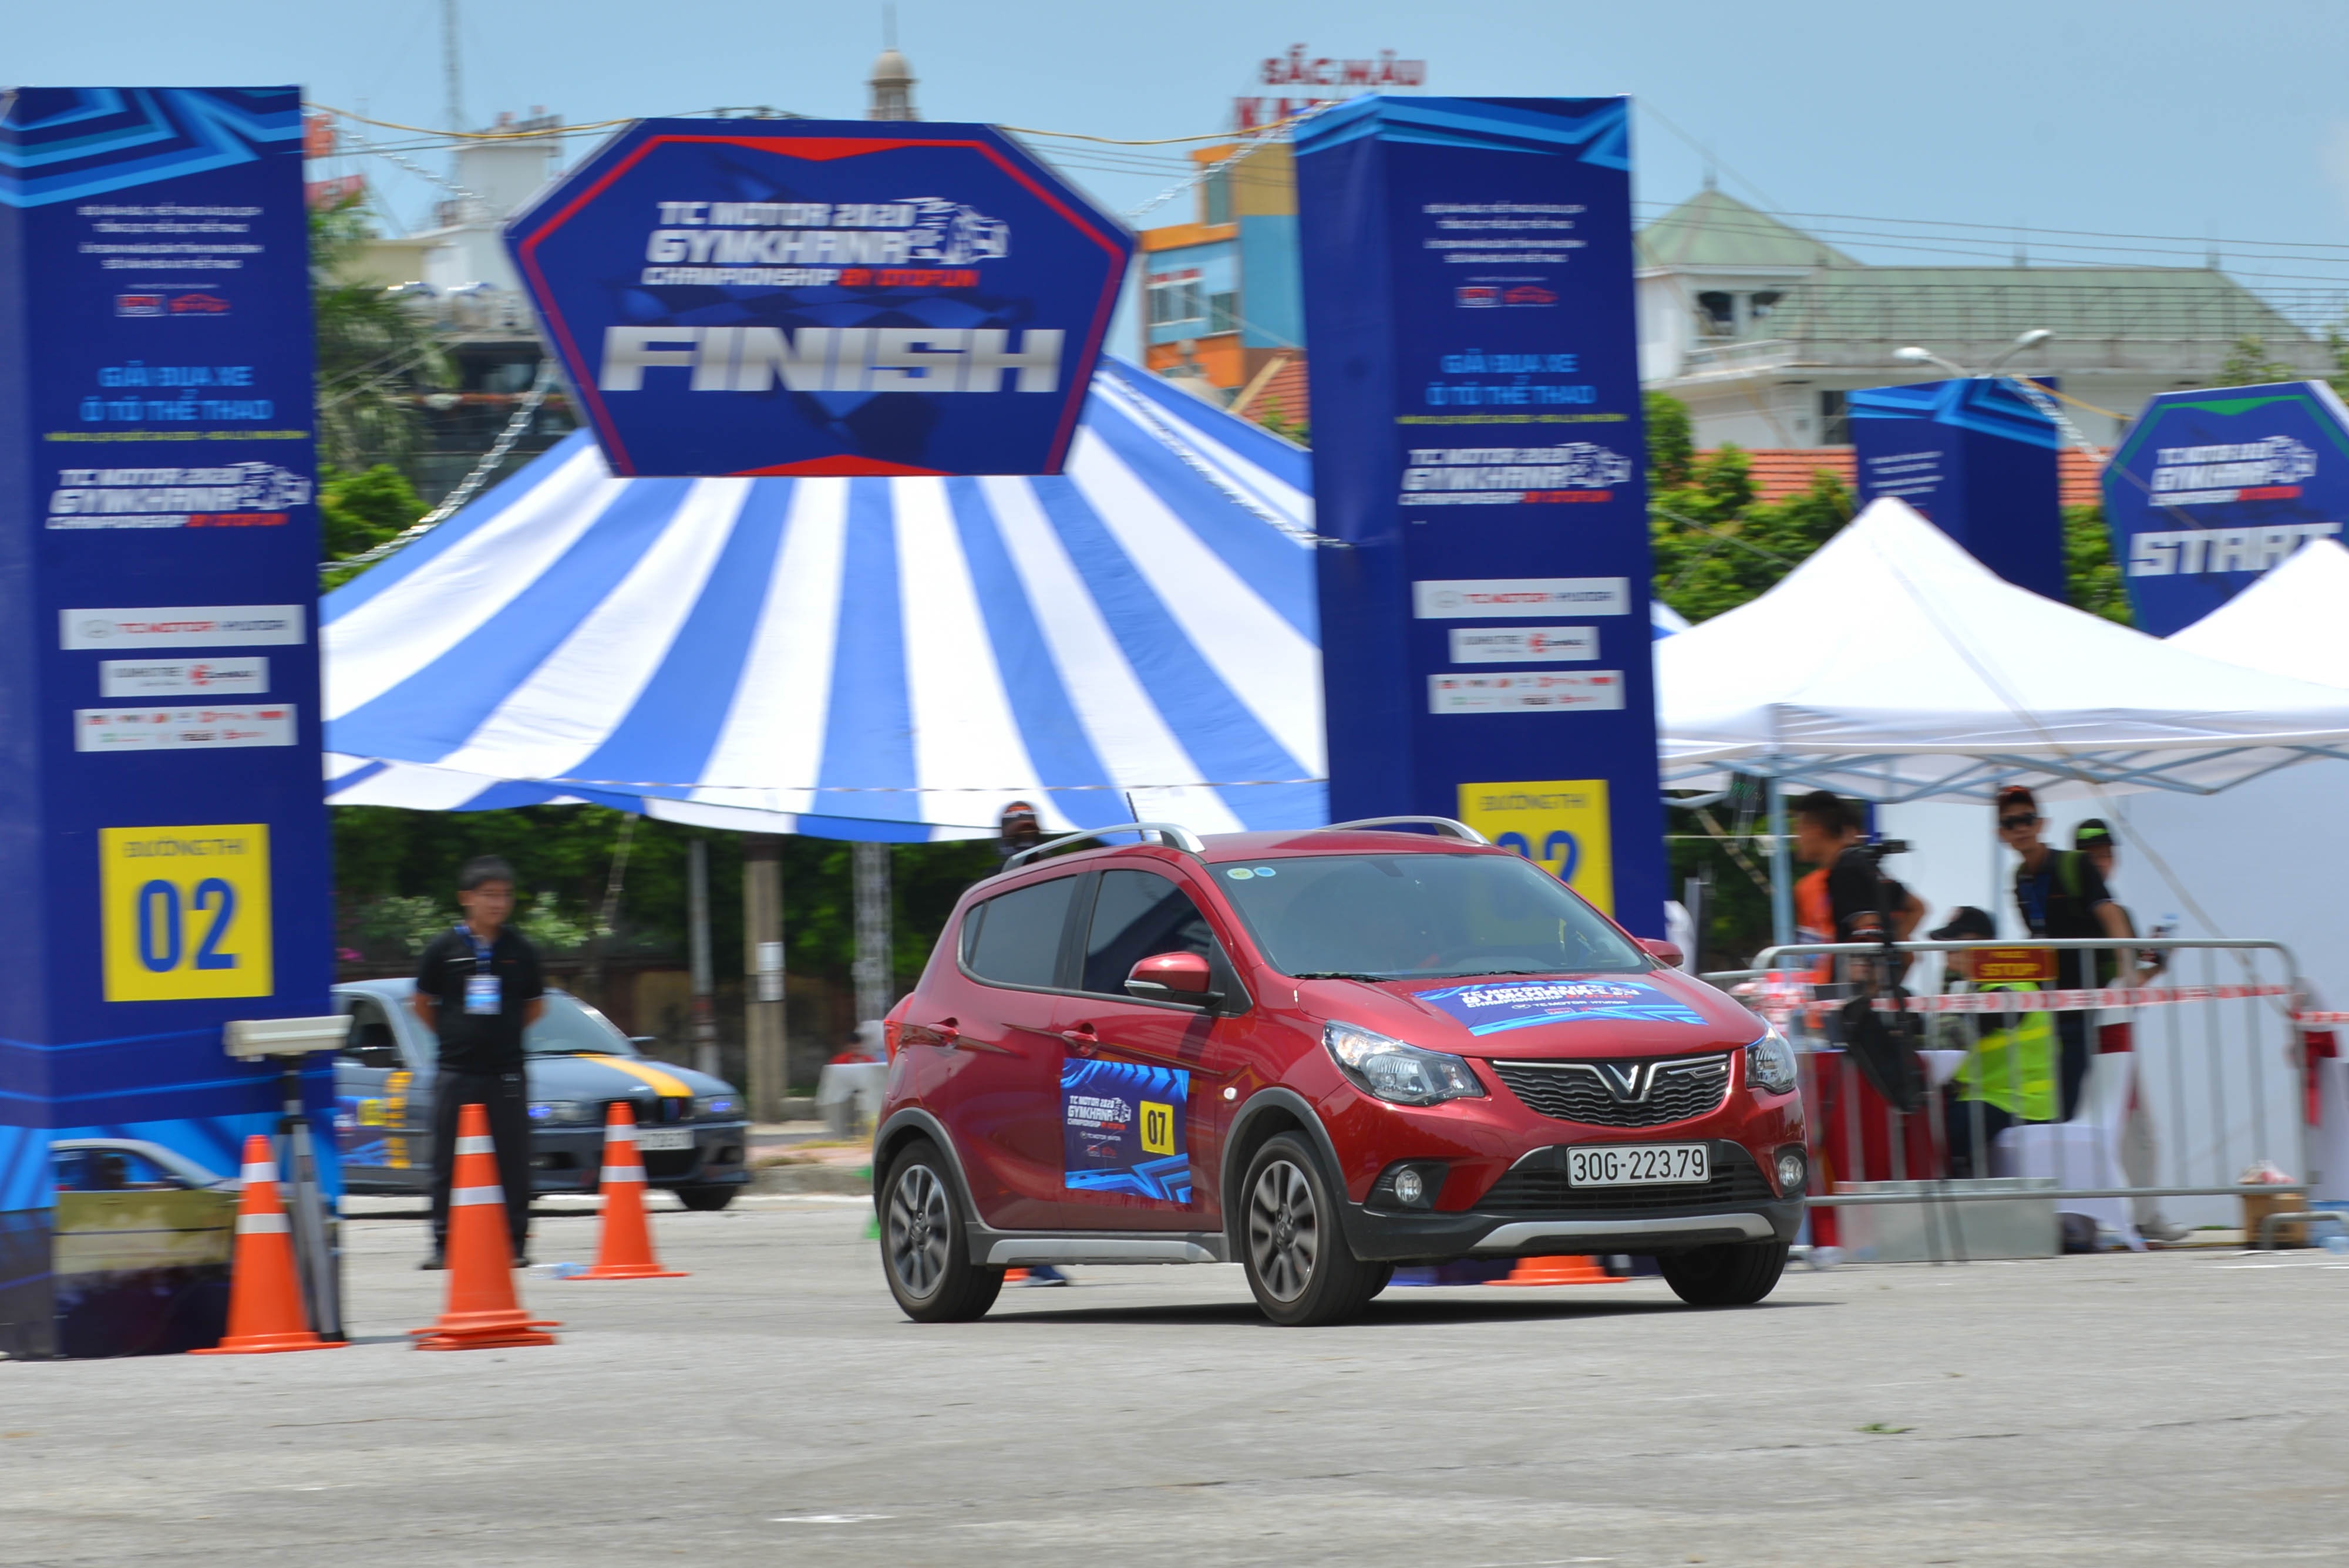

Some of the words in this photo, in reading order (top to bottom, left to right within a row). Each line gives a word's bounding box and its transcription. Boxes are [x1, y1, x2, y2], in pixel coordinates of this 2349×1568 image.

[657, 201, 708, 224] TC
[708, 202, 831, 226] MOTOR
[647, 230, 911, 264] GYMKHANA
[641, 267, 840, 286] CHAMPIONSHIP
[599, 326, 1065, 392] FINISH
[135, 877, 240, 973] 02
[1068, 1105, 1113, 1122] GYMKHANA
[1147, 1109, 1166, 1146] 07
[1573, 1149, 1704, 1182] 30G-223.79
